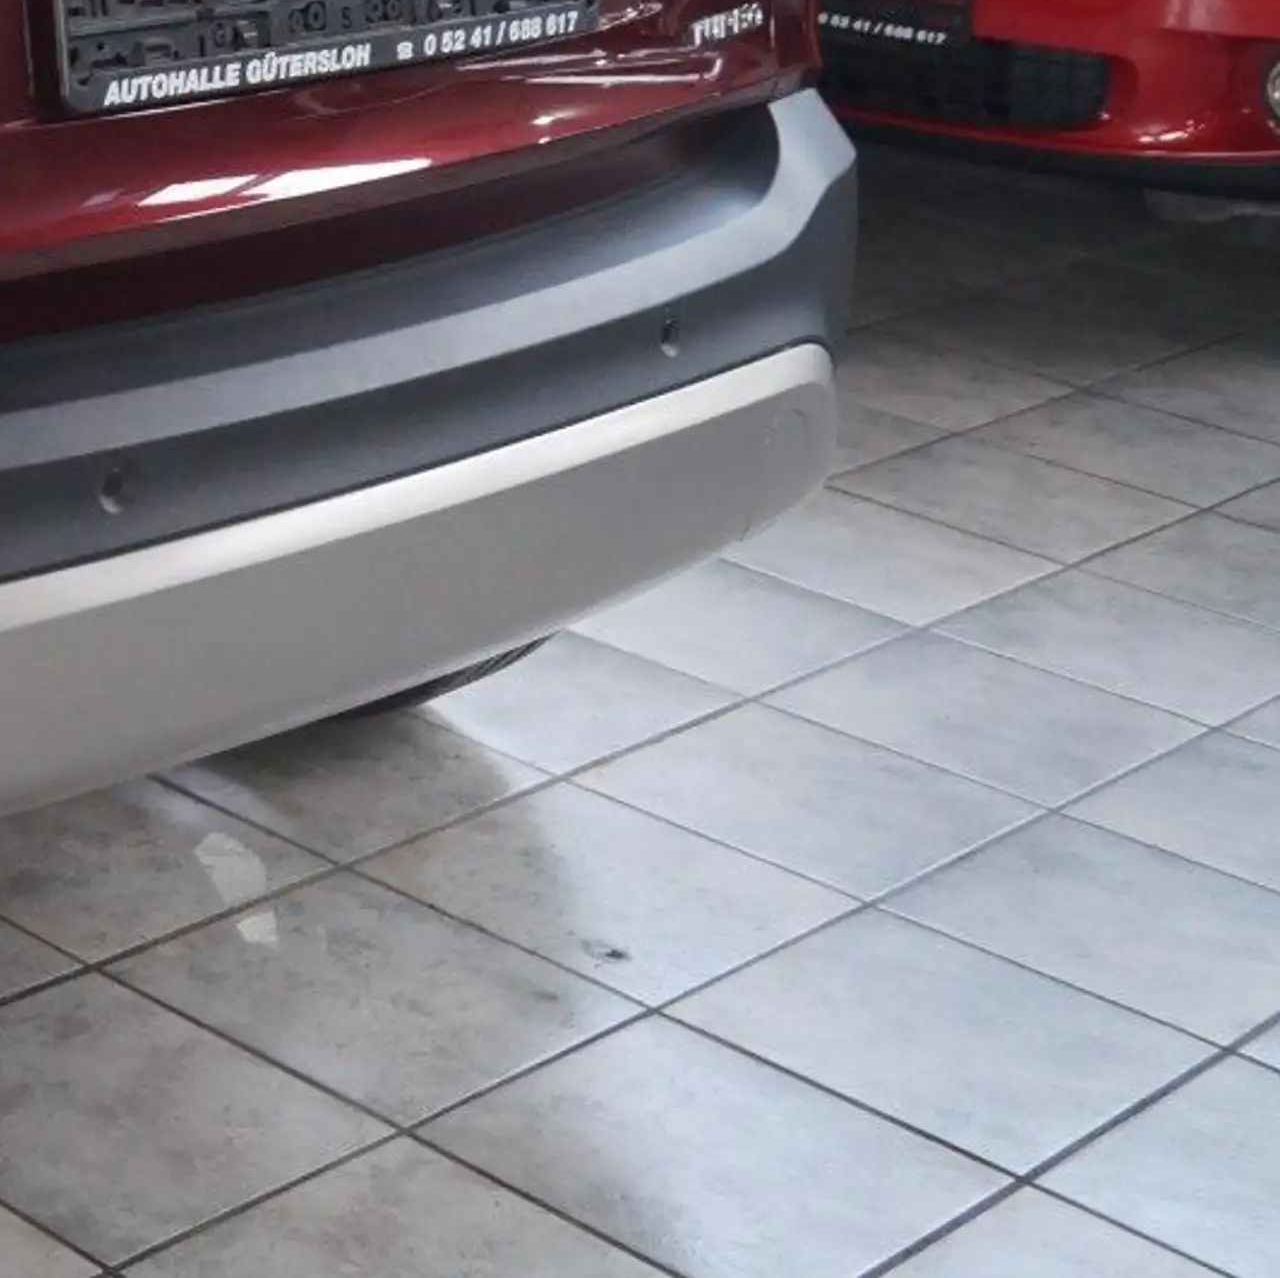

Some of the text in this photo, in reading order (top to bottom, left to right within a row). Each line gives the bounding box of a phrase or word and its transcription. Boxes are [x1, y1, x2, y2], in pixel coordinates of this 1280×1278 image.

[103, 63, 241, 107] AUTOHALLE
[246, 43, 372, 85] GÜTERSLOH
[424, 33, 437, 56] 0
[441, 28, 466, 54] 52
[469, 25, 492, 48] 41
[495, 21, 507, 45] /
[545, 10, 579, 37] 617
